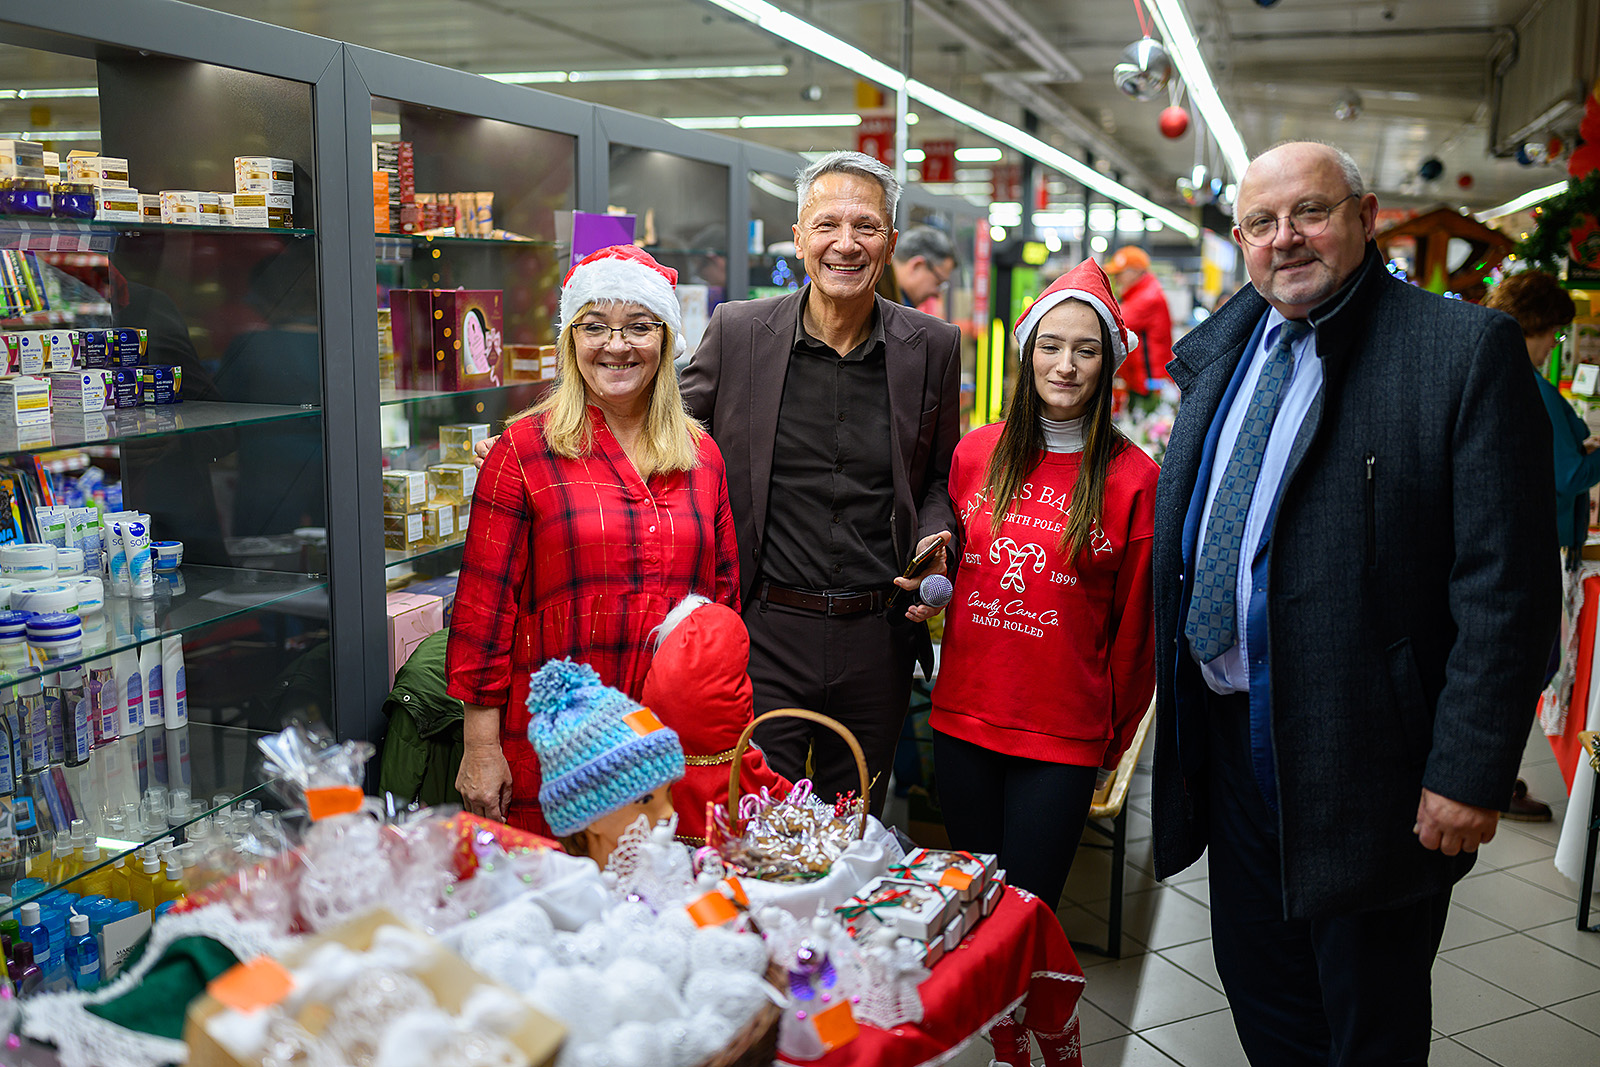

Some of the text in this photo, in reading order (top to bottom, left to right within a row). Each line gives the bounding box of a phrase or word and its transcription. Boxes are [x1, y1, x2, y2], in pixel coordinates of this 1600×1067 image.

[1001, 512, 1061, 533] ORTH POLE
[1036, 485, 1113, 556] BARY
[1049, 570, 1077, 587] 1899
[968, 590, 1059, 627] Candy Cane Co.
[971, 613, 1044, 638] HAND ROLLED
